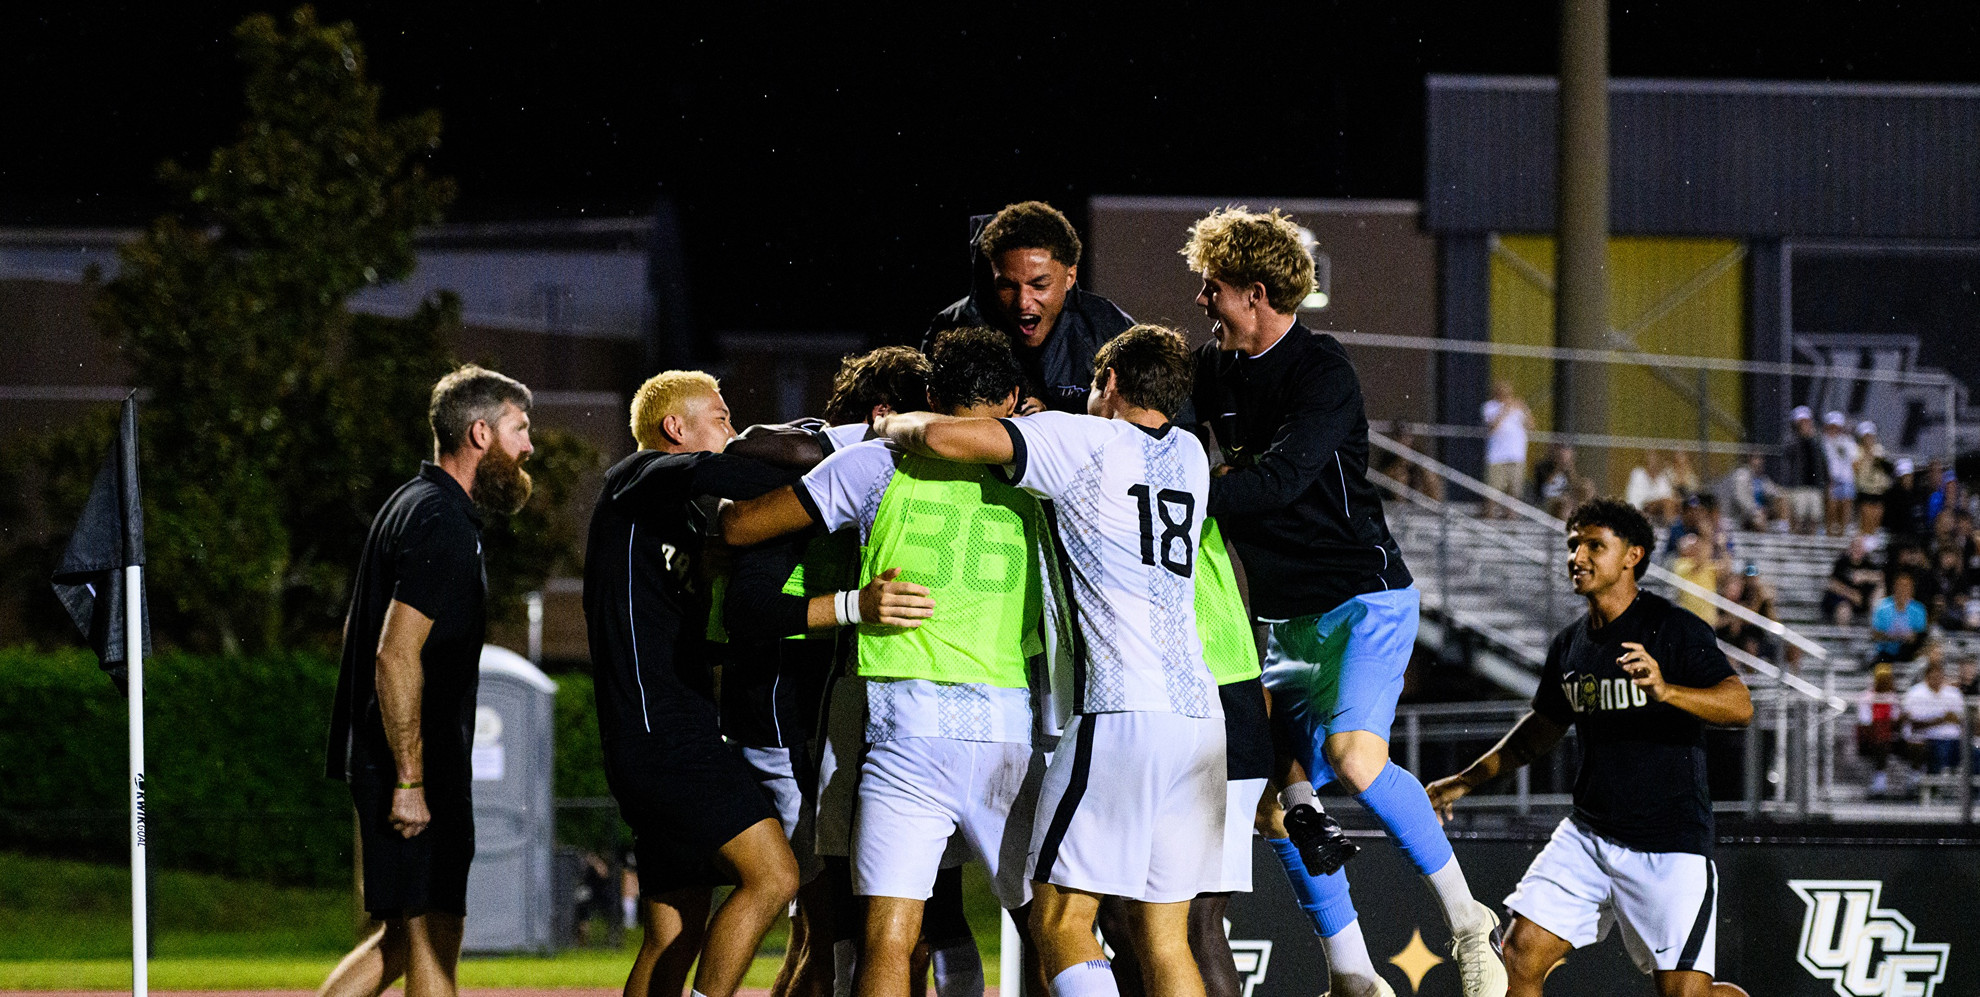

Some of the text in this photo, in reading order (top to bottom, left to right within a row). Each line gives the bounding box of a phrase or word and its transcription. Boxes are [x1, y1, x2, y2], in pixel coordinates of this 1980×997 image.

[896, 499, 1028, 593] 36
[1127, 483, 1196, 579] 18
[1787, 879, 1951, 997] UCF
